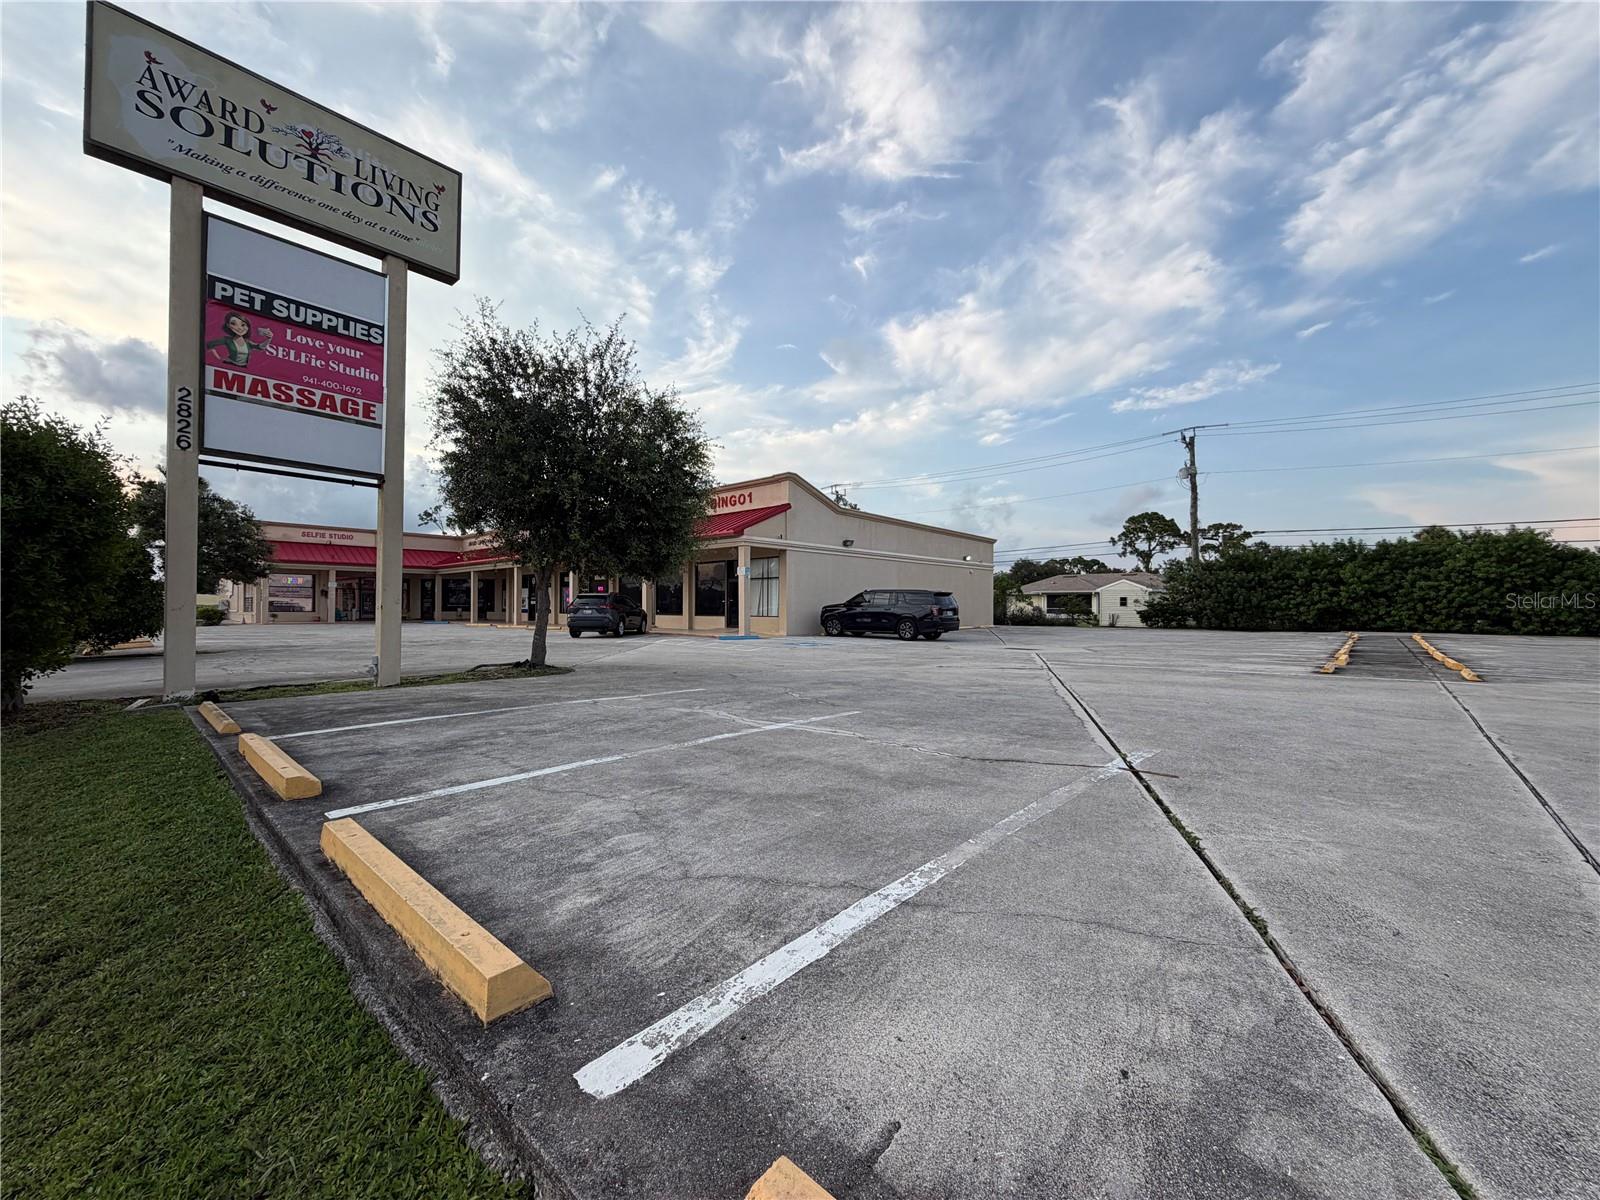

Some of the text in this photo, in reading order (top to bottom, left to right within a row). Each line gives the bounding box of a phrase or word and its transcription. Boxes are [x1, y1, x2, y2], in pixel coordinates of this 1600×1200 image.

[135, 65, 440, 211] AWARD LIVING
[135, 89, 439, 233] SOLUTIONS
[167, 139, 235, 174] "Making
[236, 170, 246, 178] a
[249, 172, 316, 205] difference
[318, 201, 340, 214] one
[342, 208, 363, 225] day
[365, 221, 378, 231] at
[379, 225, 388, 233] a
[214, 281, 383, 345] PET SUPPLIES
[286, 329, 364, 360] Love your
[213, 369, 377, 421] MASSAGE
[266, 345, 380, 382] SELFie Studio
[302, 375, 362, 396] 941-400-1672
[176, 386, 192, 451] 2826
